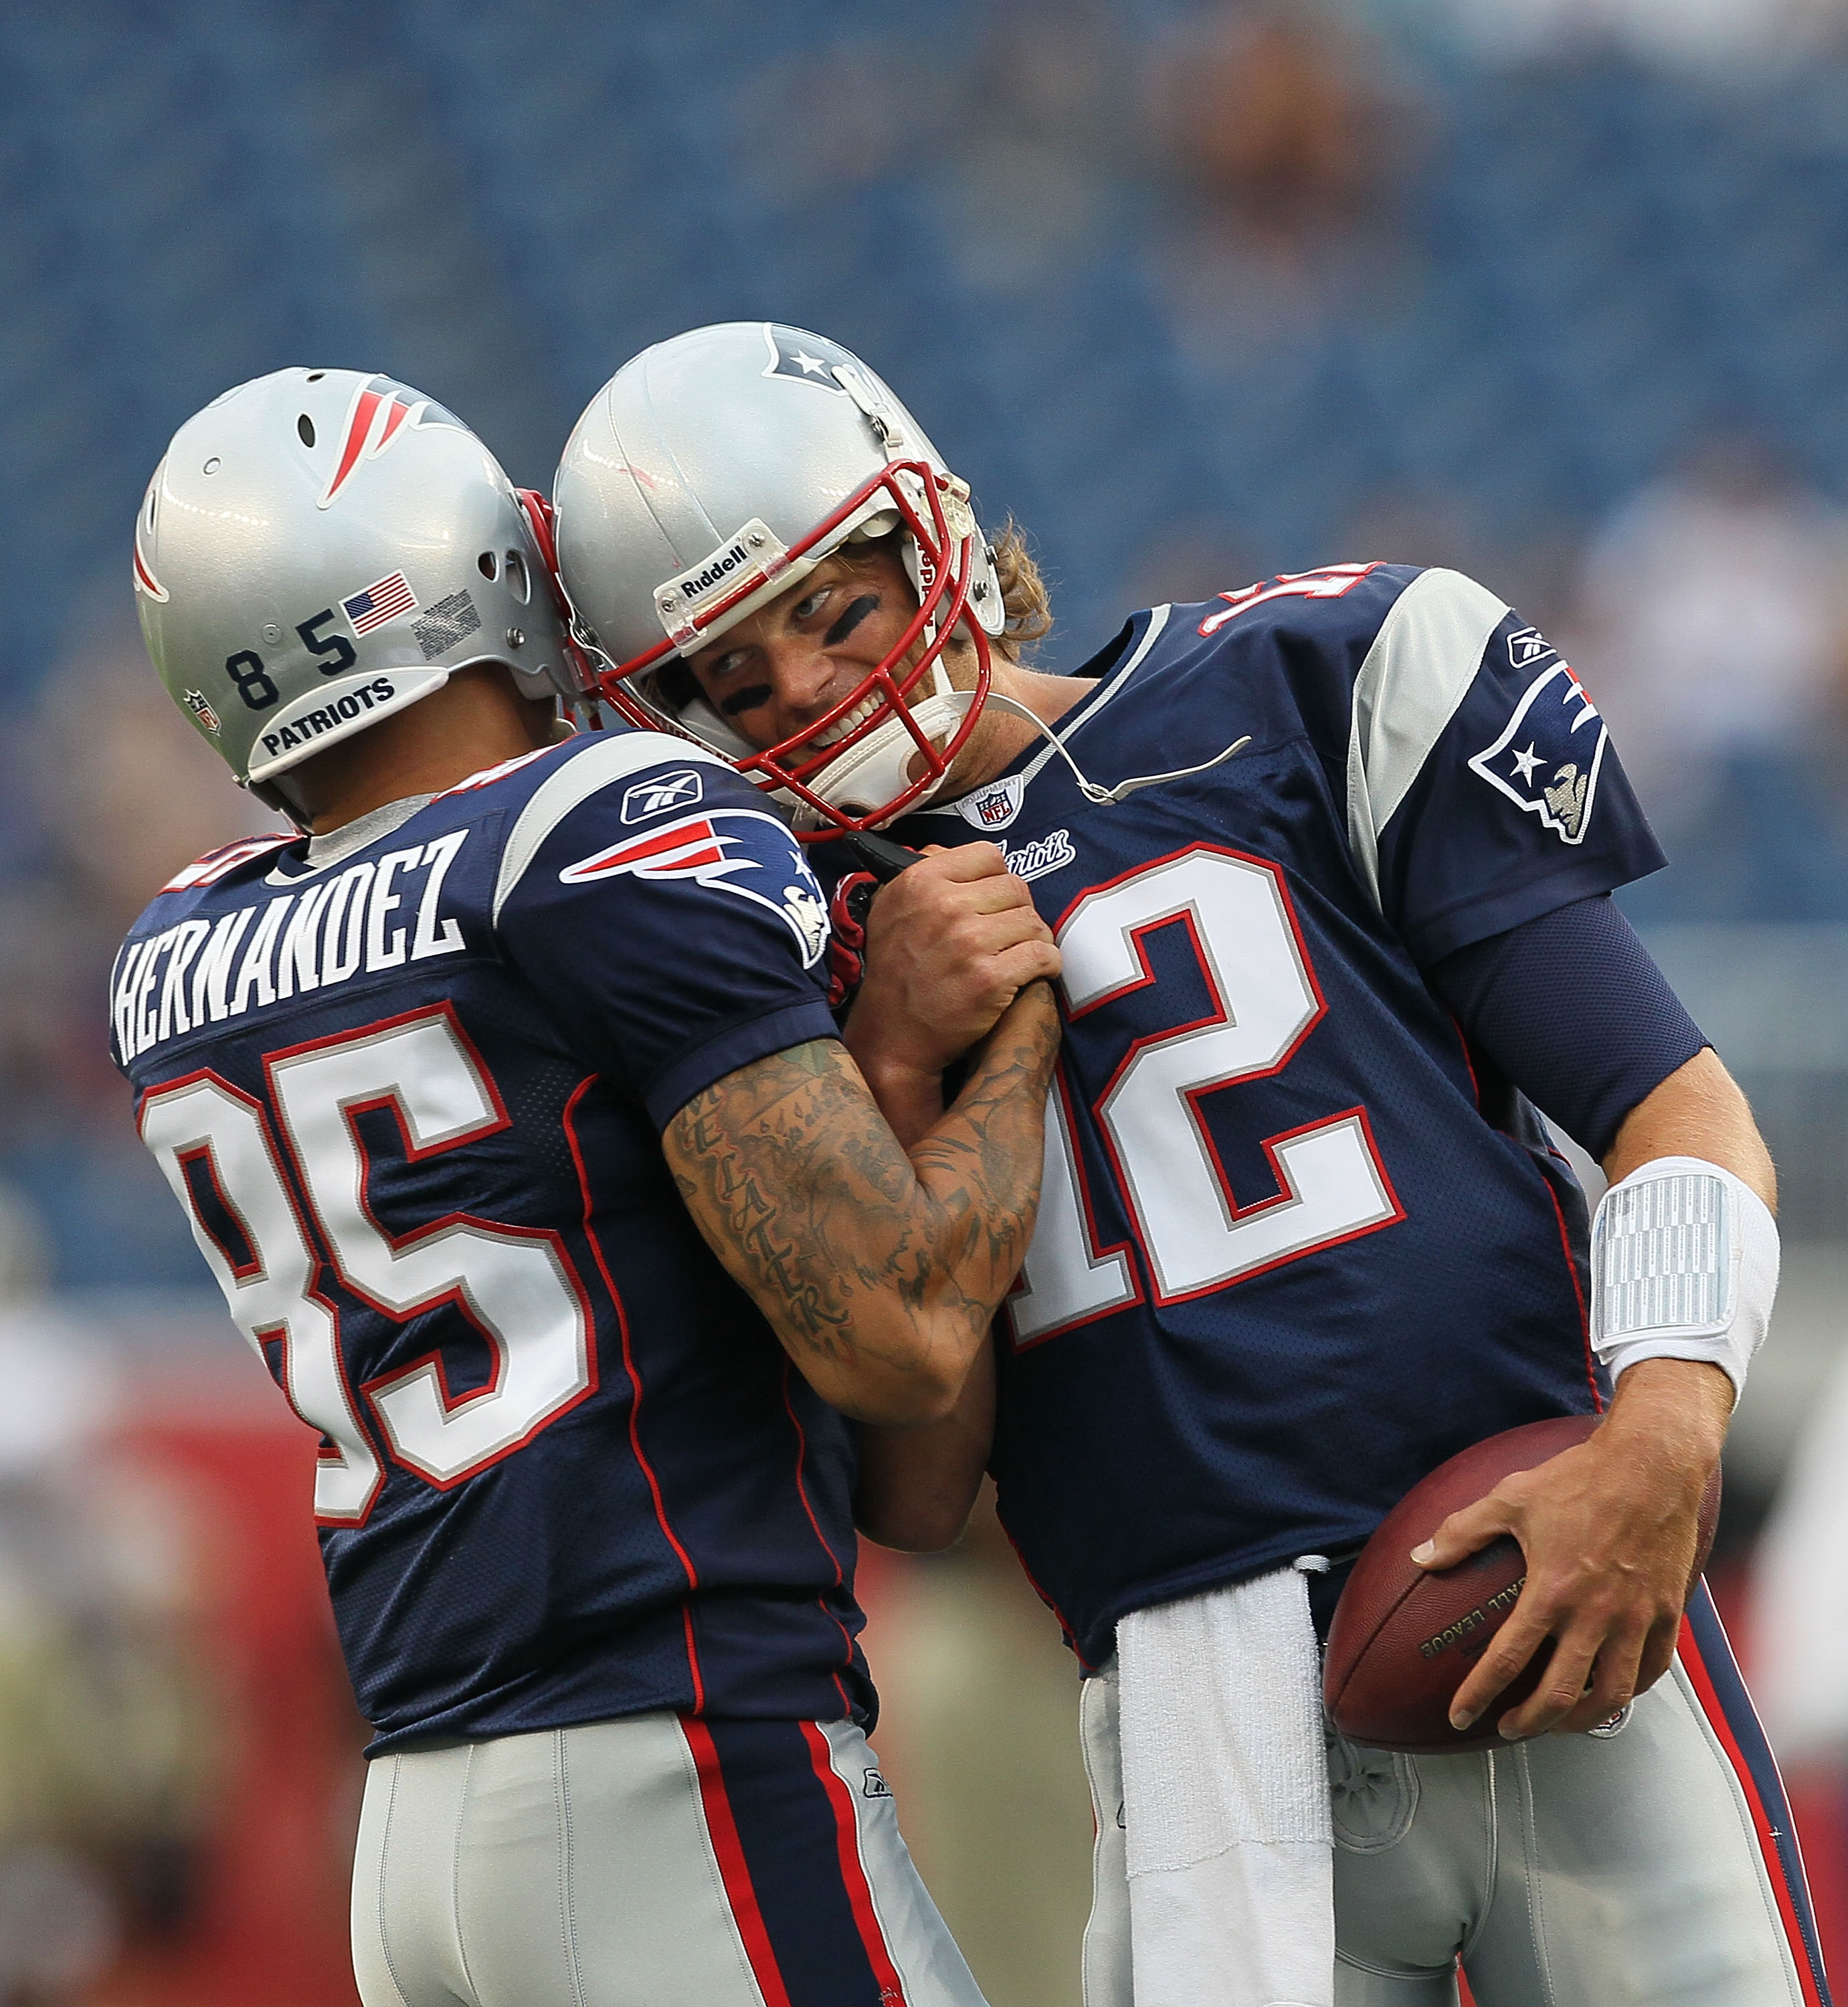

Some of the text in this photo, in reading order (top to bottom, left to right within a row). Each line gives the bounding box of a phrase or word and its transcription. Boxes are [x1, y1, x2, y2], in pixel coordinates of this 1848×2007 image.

[680, 545, 747, 598] Riddell
[262, 677, 395, 757] PATRIOTS
[982, 802, 1011, 823] NFL
[1004, 830, 1076, 878] triots
[114, 828, 467, 1066] HERNANDEZ
[136, 999, 599, 1528] 85
[1420, 1608, 1487, 1658] LEAGUE
